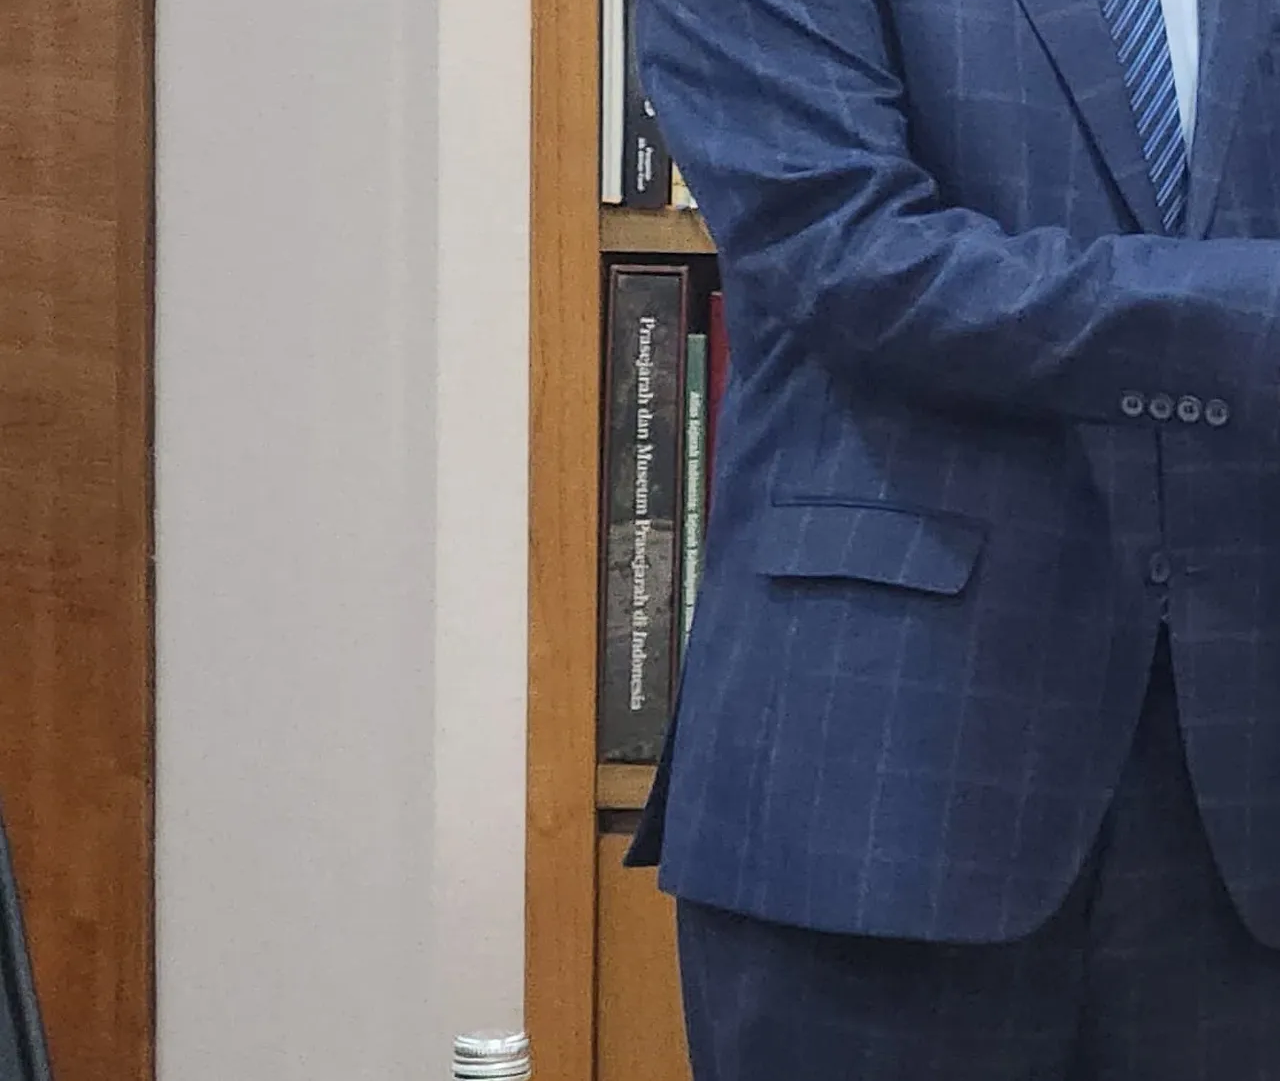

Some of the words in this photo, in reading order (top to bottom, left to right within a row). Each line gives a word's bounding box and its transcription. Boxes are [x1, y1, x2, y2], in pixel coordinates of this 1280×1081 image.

[634, 316, 656, 405] Prasejarah
[636, 407, 655, 440] dan
[634, 443, 654, 515] Museum
[629, 518, 653, 607] Prasejarah
[631, 609, 649, 628] di
[628, 630, 649, 711] Indonesia
